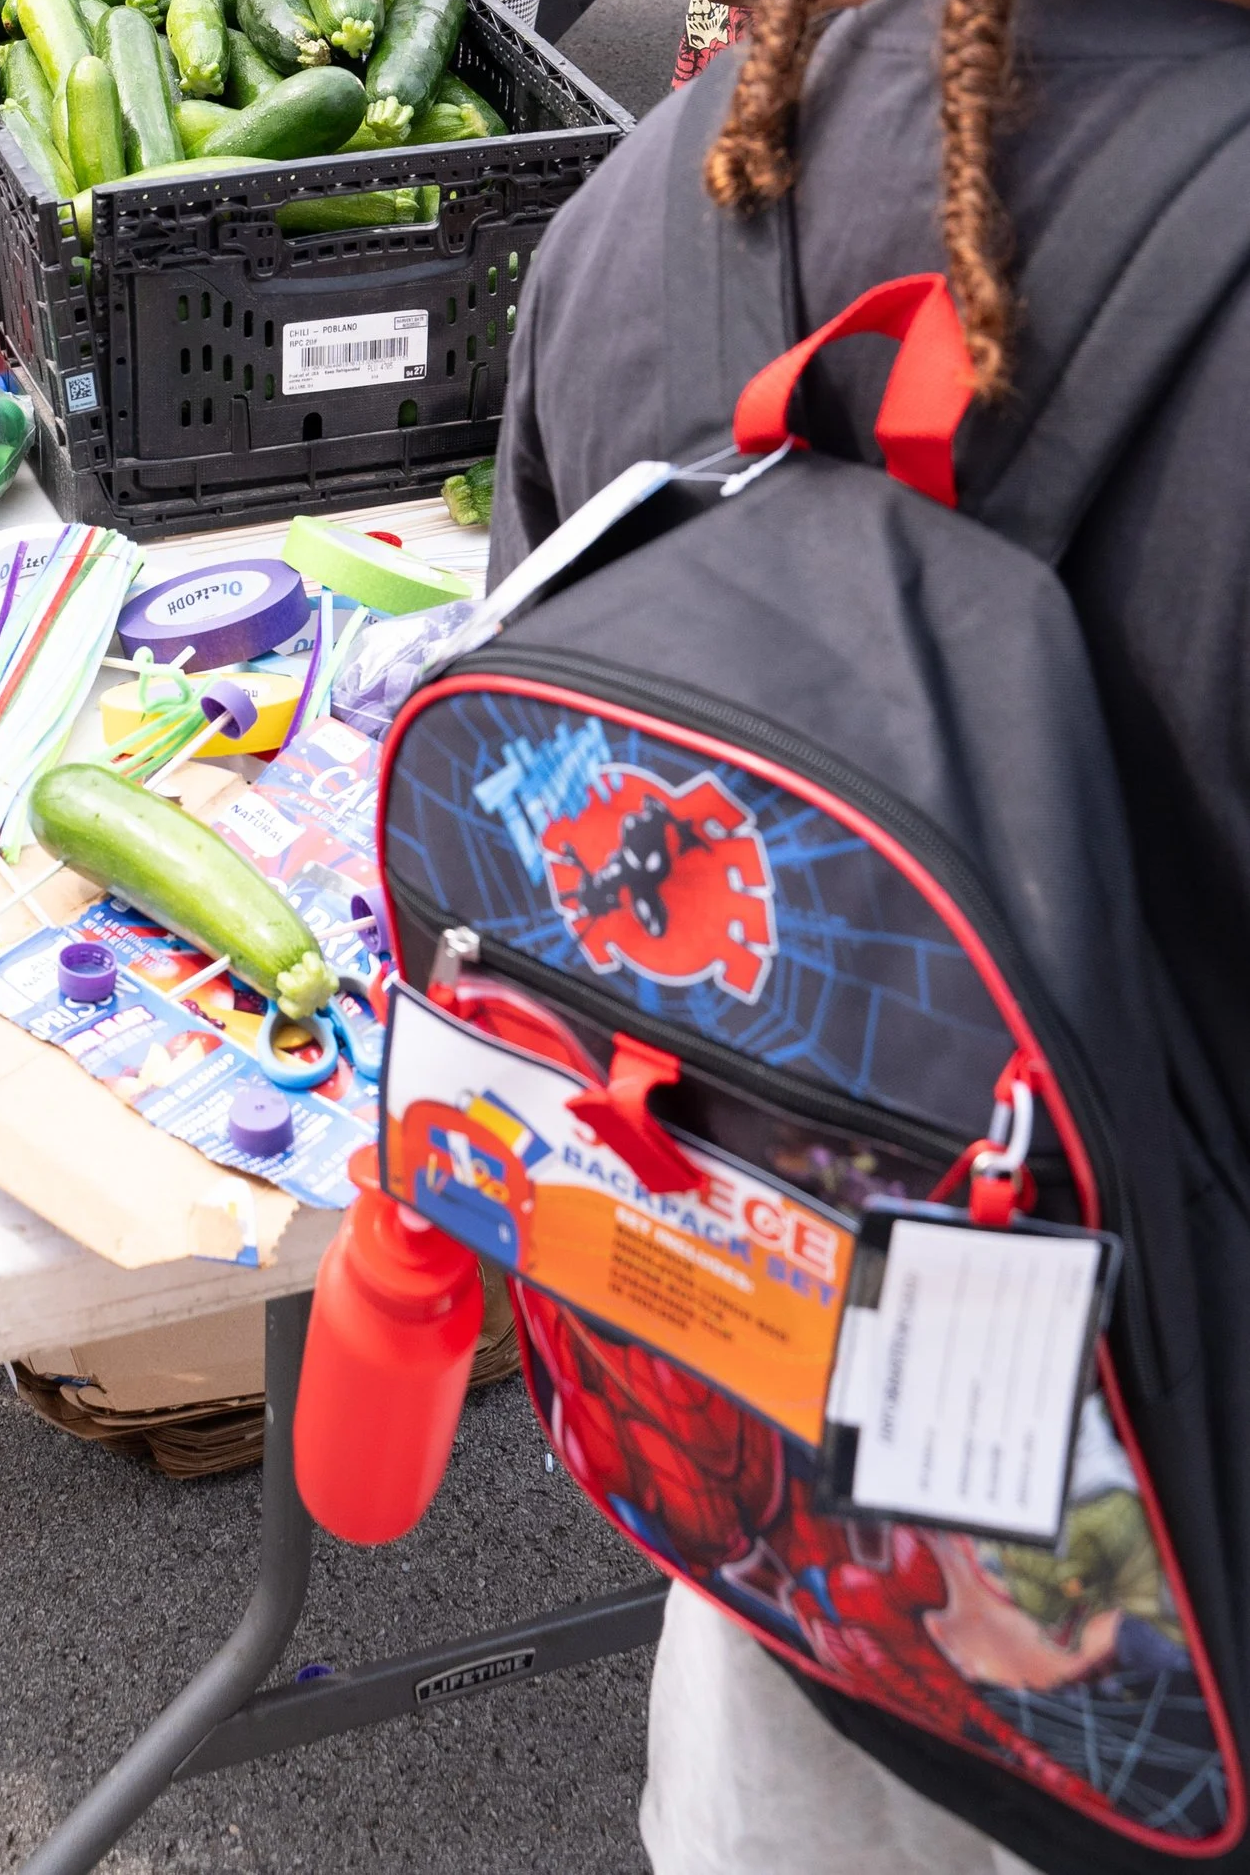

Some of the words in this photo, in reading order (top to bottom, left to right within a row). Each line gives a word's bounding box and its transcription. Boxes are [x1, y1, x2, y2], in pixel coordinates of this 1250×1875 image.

[289, 328, 310, 338] CHILI
[322, 323, 358, 334] POBLANO
[414, 365, 424, 376] 27
[230, 804, 284, 844] NATURAL
[428, 1654, 527, 1697] LIFETIME
